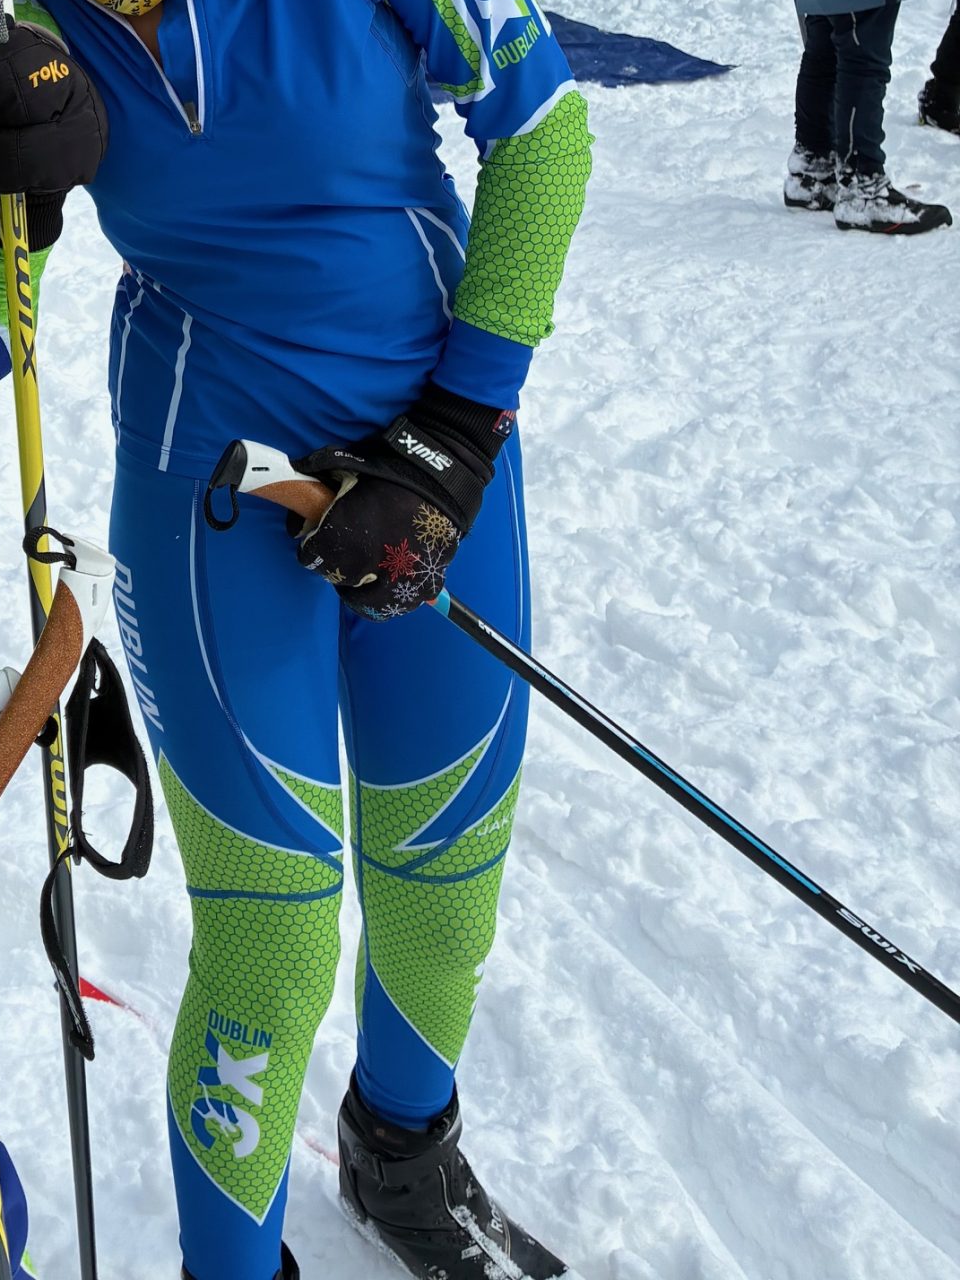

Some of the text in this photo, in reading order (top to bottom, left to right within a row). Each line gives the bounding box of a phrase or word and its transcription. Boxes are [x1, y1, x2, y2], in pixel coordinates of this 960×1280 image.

[492, 17, 541, 70] DUBLIN
[28, 59, 70, 89] TOKO
[113, 560, 165, 733] DUBLIN
[208, 1008, 273, 1048] DUBLIN
